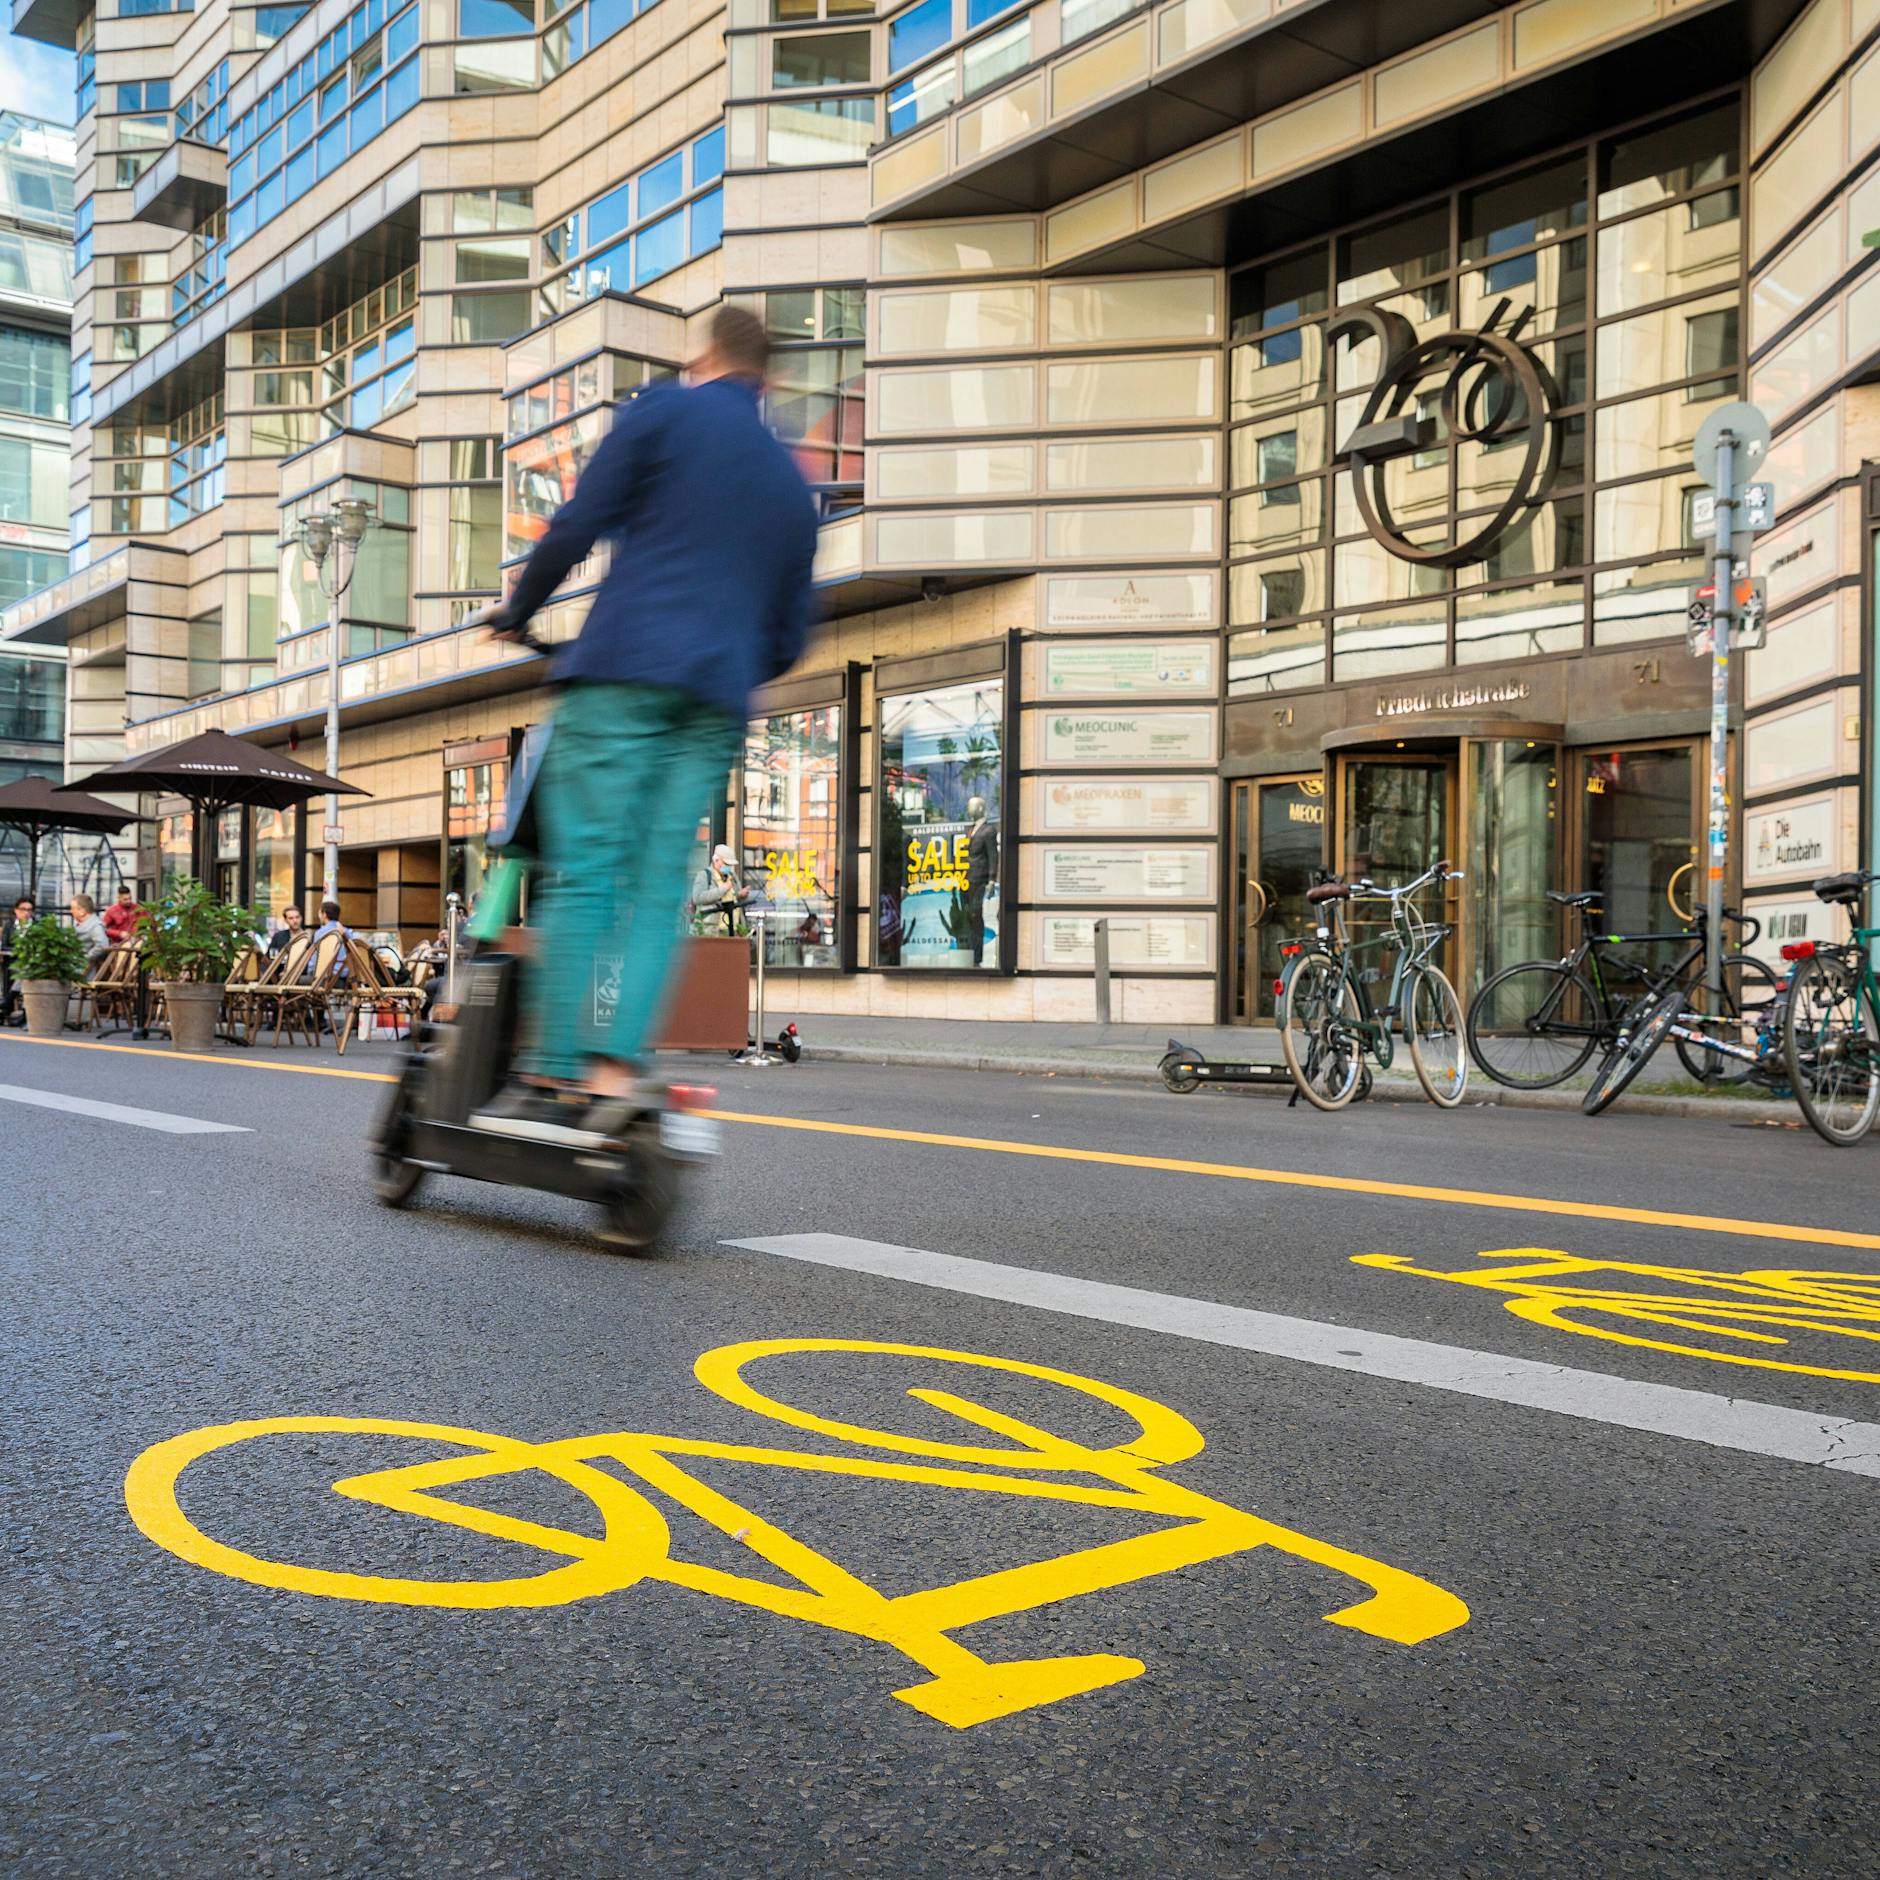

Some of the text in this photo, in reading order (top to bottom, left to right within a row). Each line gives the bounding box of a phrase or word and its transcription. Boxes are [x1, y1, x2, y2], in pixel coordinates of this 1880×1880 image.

[1074, 721, 1138, 733] MEOCLINIC
[179, 763, 239, 771] EINSTEIN
[1776, 820, 1790, 839] Die
[907, 838, 970, 873] SALE
[1775, 843, 1822, 863] Autobahn
[765, 850, 817, 880] SALE
